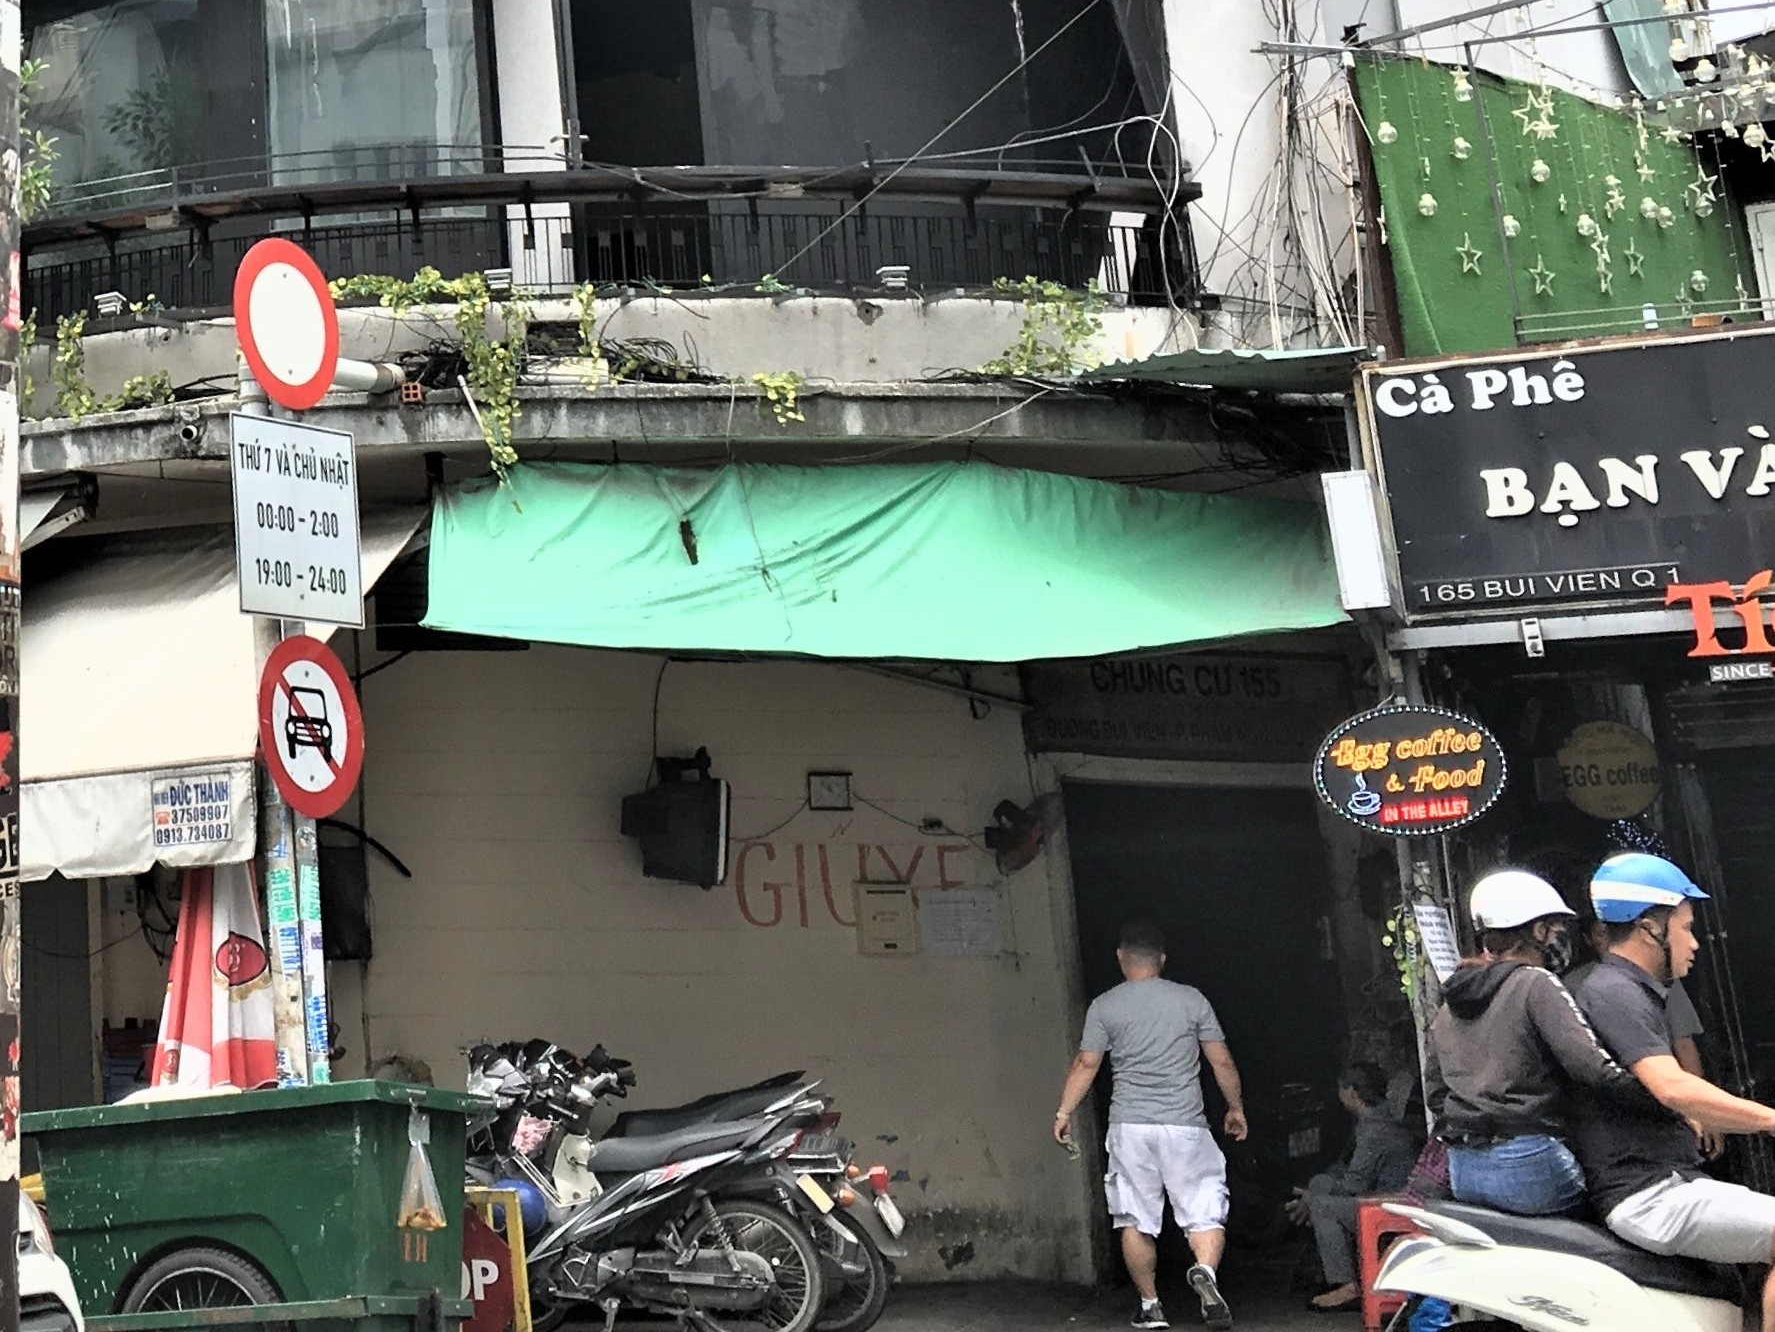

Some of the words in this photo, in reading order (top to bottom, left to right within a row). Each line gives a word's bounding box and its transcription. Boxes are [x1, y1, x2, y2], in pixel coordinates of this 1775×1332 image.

[1375, 374, 1455, 418] Cà
[1466, 359, 1586, 410] Phê
[238, 438, 262, 471] THỨ
[264, 447, 272, 474] 7
[275, 443, 292, 477] VÀ
[320, 452, 350, 490] NHẬT
[1479, 454, 1660, 528] BẠN
[257, 502, 295, 532] 00:00
[310, 510, 339, 538] 2:00
[255, 557, 292, 587] 19:00
[309, 565, 347, 596] 24:00
[1419, 582, 1475, 603] 165
[1484, 578, 1536, 598] BUI
[1547, 572, 1621, 595] VIEN
[1631, 569, 1655, 587] Q
[1712, 664, 1770, 680] SINCE
[1331, 738, 1392, 772] Egg
[1396, 728, 1482, 760] coffee
[170, 780, 192, 807] ĐỨC
[193, 777, 229, 805] THÀNH
[1386, 773, 1405, 793] &
[1409, 759, 1486, 793] Food
[1385, 807, 1399, 823] IN
[1403, 803, 1427, 820] THE
[1430, 799, 1469, 818] ALLEY
